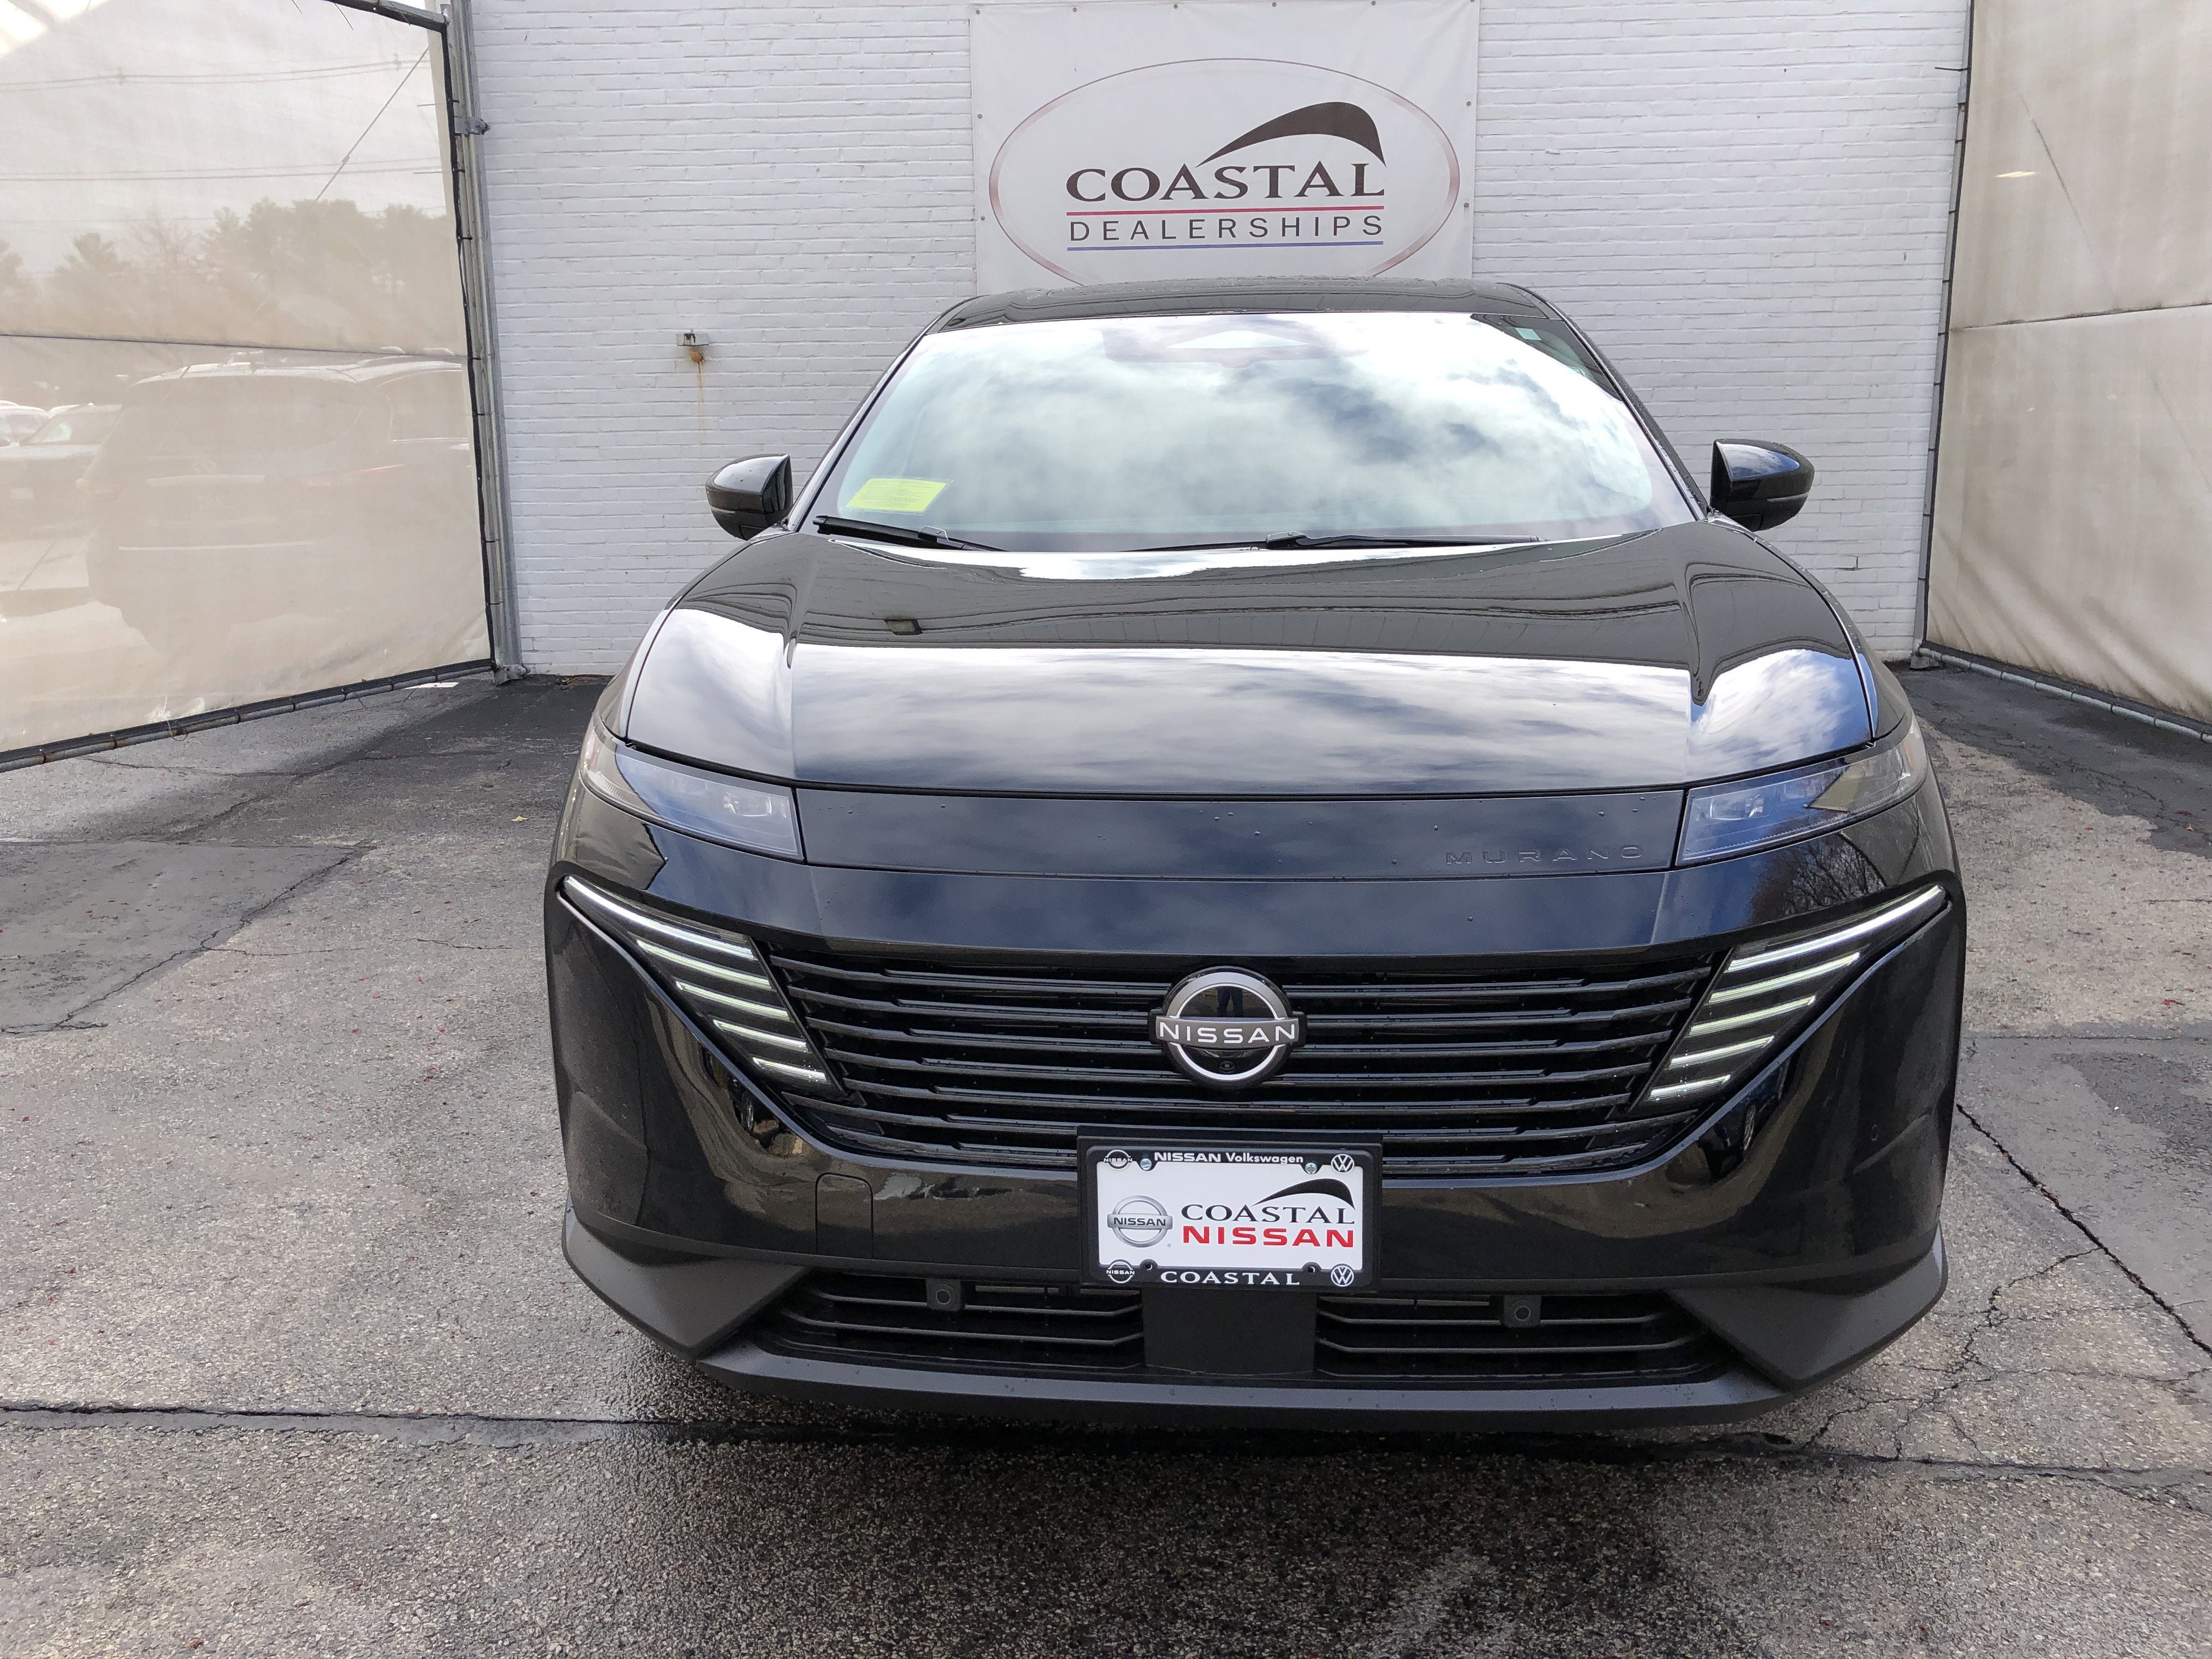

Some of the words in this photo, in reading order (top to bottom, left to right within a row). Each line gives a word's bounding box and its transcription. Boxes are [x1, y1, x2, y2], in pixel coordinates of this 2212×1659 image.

[1066, 161, 1385, 201] COASTAL
[1070, 215, 1383, 241] DEALERSHIPS
[1446, 844, 1643, 864] MURANO
[1160, 1022, 1295, 1043] NISSAN
[1154, 1152, 1221, 1163] NISSAN
[1226, 1153, 1304, 1164] Volkswagen
[1114, 1216, 1166, 1227] NISSAN
[1181, 1204, 1355, 1224] COASTAL
[1183, 1226, 1353, 1248] NISSAN
[1161, 1271, 1300, 1285] COASTAL
